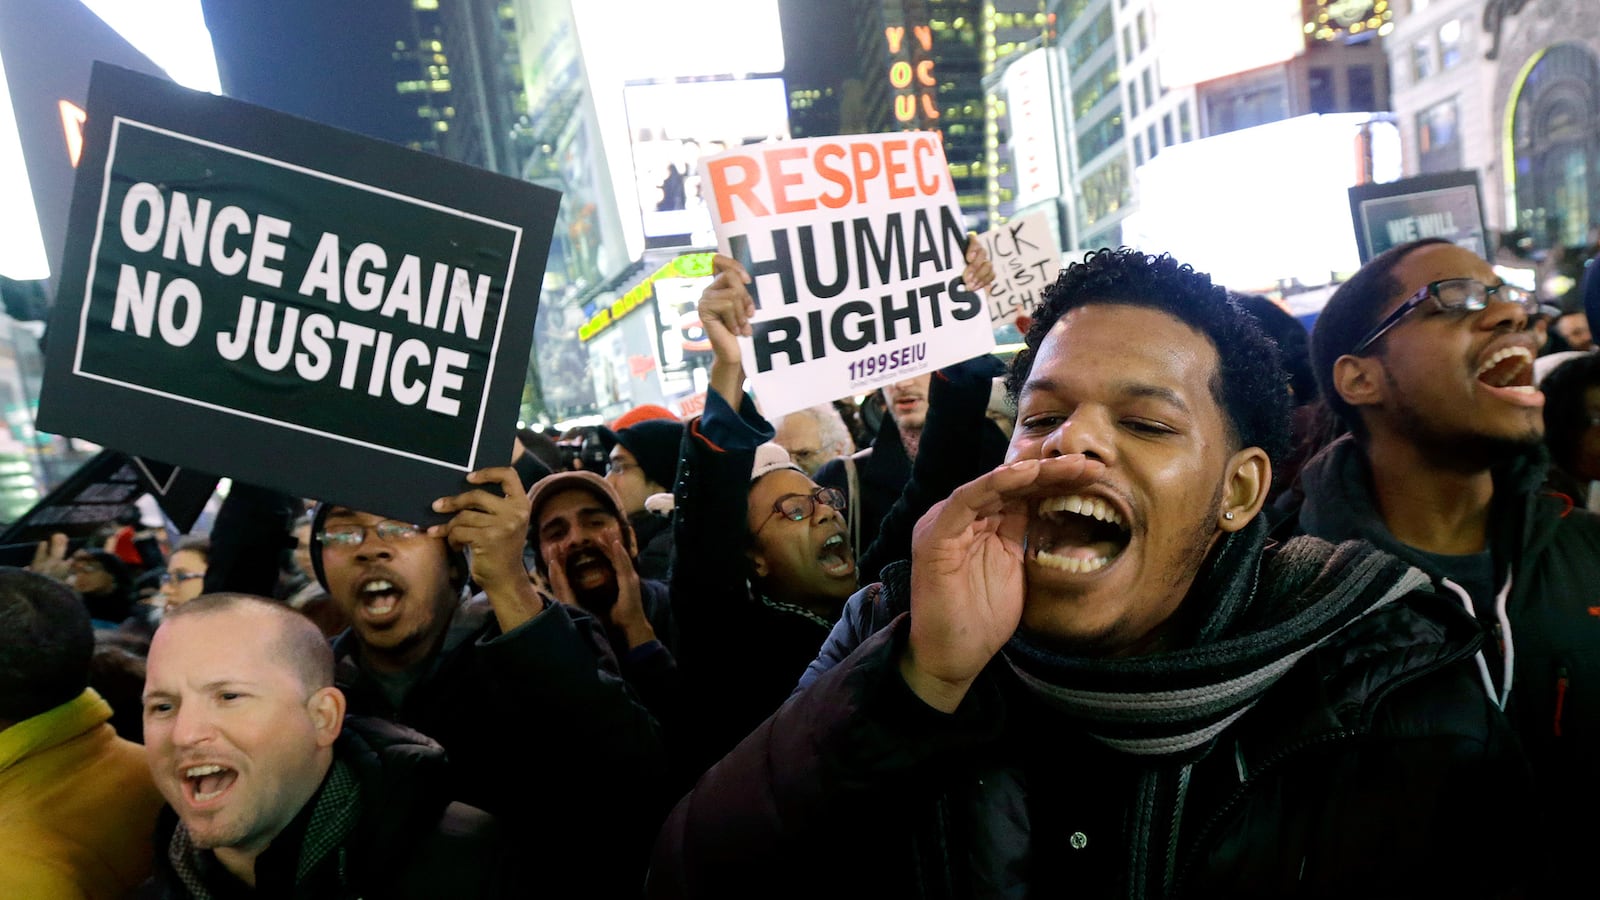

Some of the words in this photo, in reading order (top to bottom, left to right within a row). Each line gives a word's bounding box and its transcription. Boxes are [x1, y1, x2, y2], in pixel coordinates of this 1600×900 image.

[884, 26, 921, 132] YOU
[120, 182, 292, 288] ONCE
[299, 232, 492, 340] AGAIN
[728, 205, 970, 310] HUMAN
[1386, 216, 1419, 243] WE
[1419, 211, 1459, 239] WILL
[111, 264, 202, 347] NO
[216, 295, 470, 417] JUSTICE
[751, 275, 982, 373] RIGHTS
[848, 342, 926, 381] 1199SEIU
